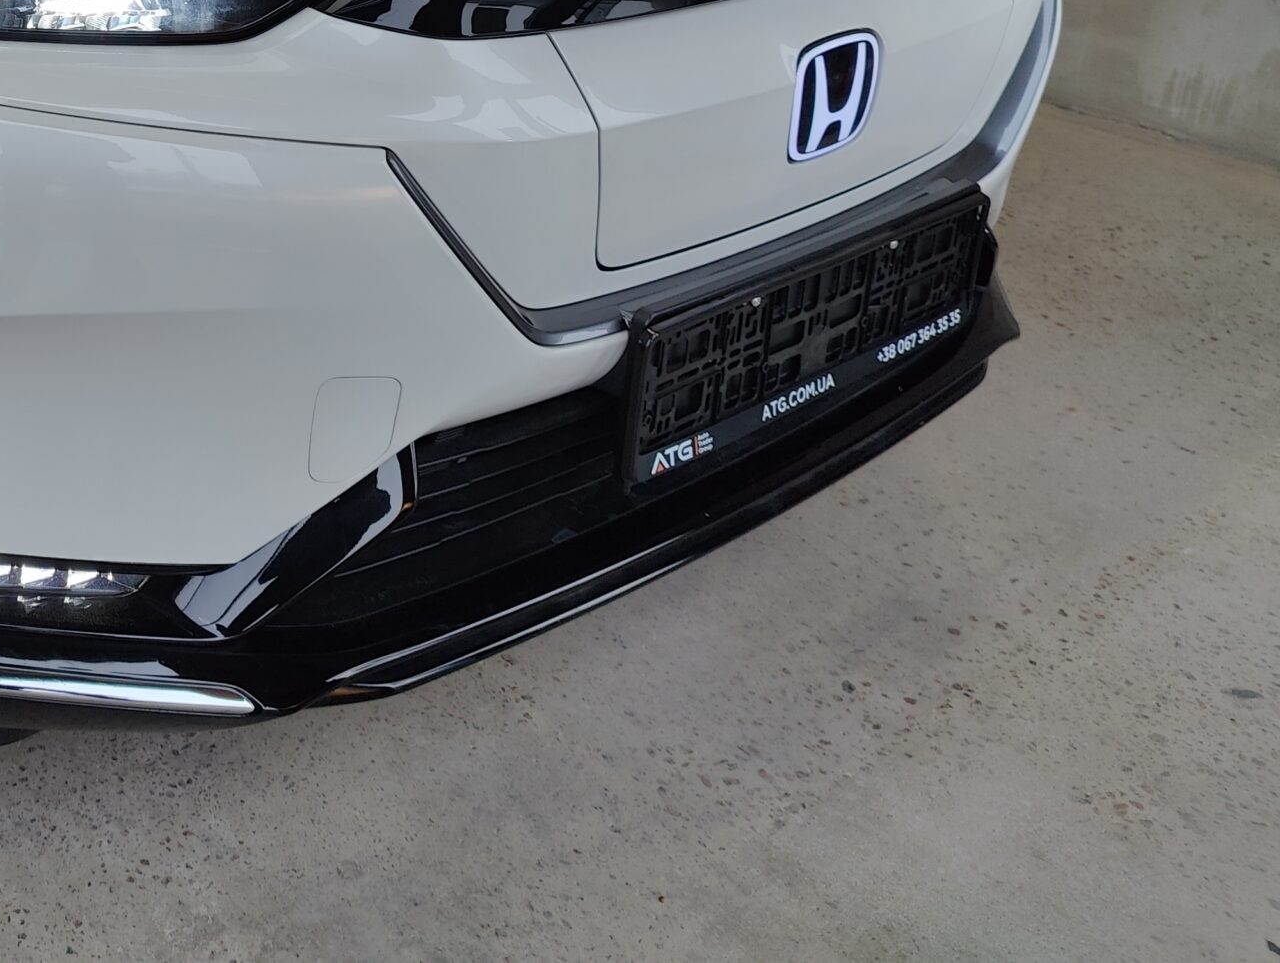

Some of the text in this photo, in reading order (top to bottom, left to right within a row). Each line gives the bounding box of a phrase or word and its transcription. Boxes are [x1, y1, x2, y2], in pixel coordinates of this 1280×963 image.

[877, 308, 961, 362] +38 067 364 35 35
[762, 373, 836, 422] ATG.COM.UA
[651, 438, 694, 475] ATG
